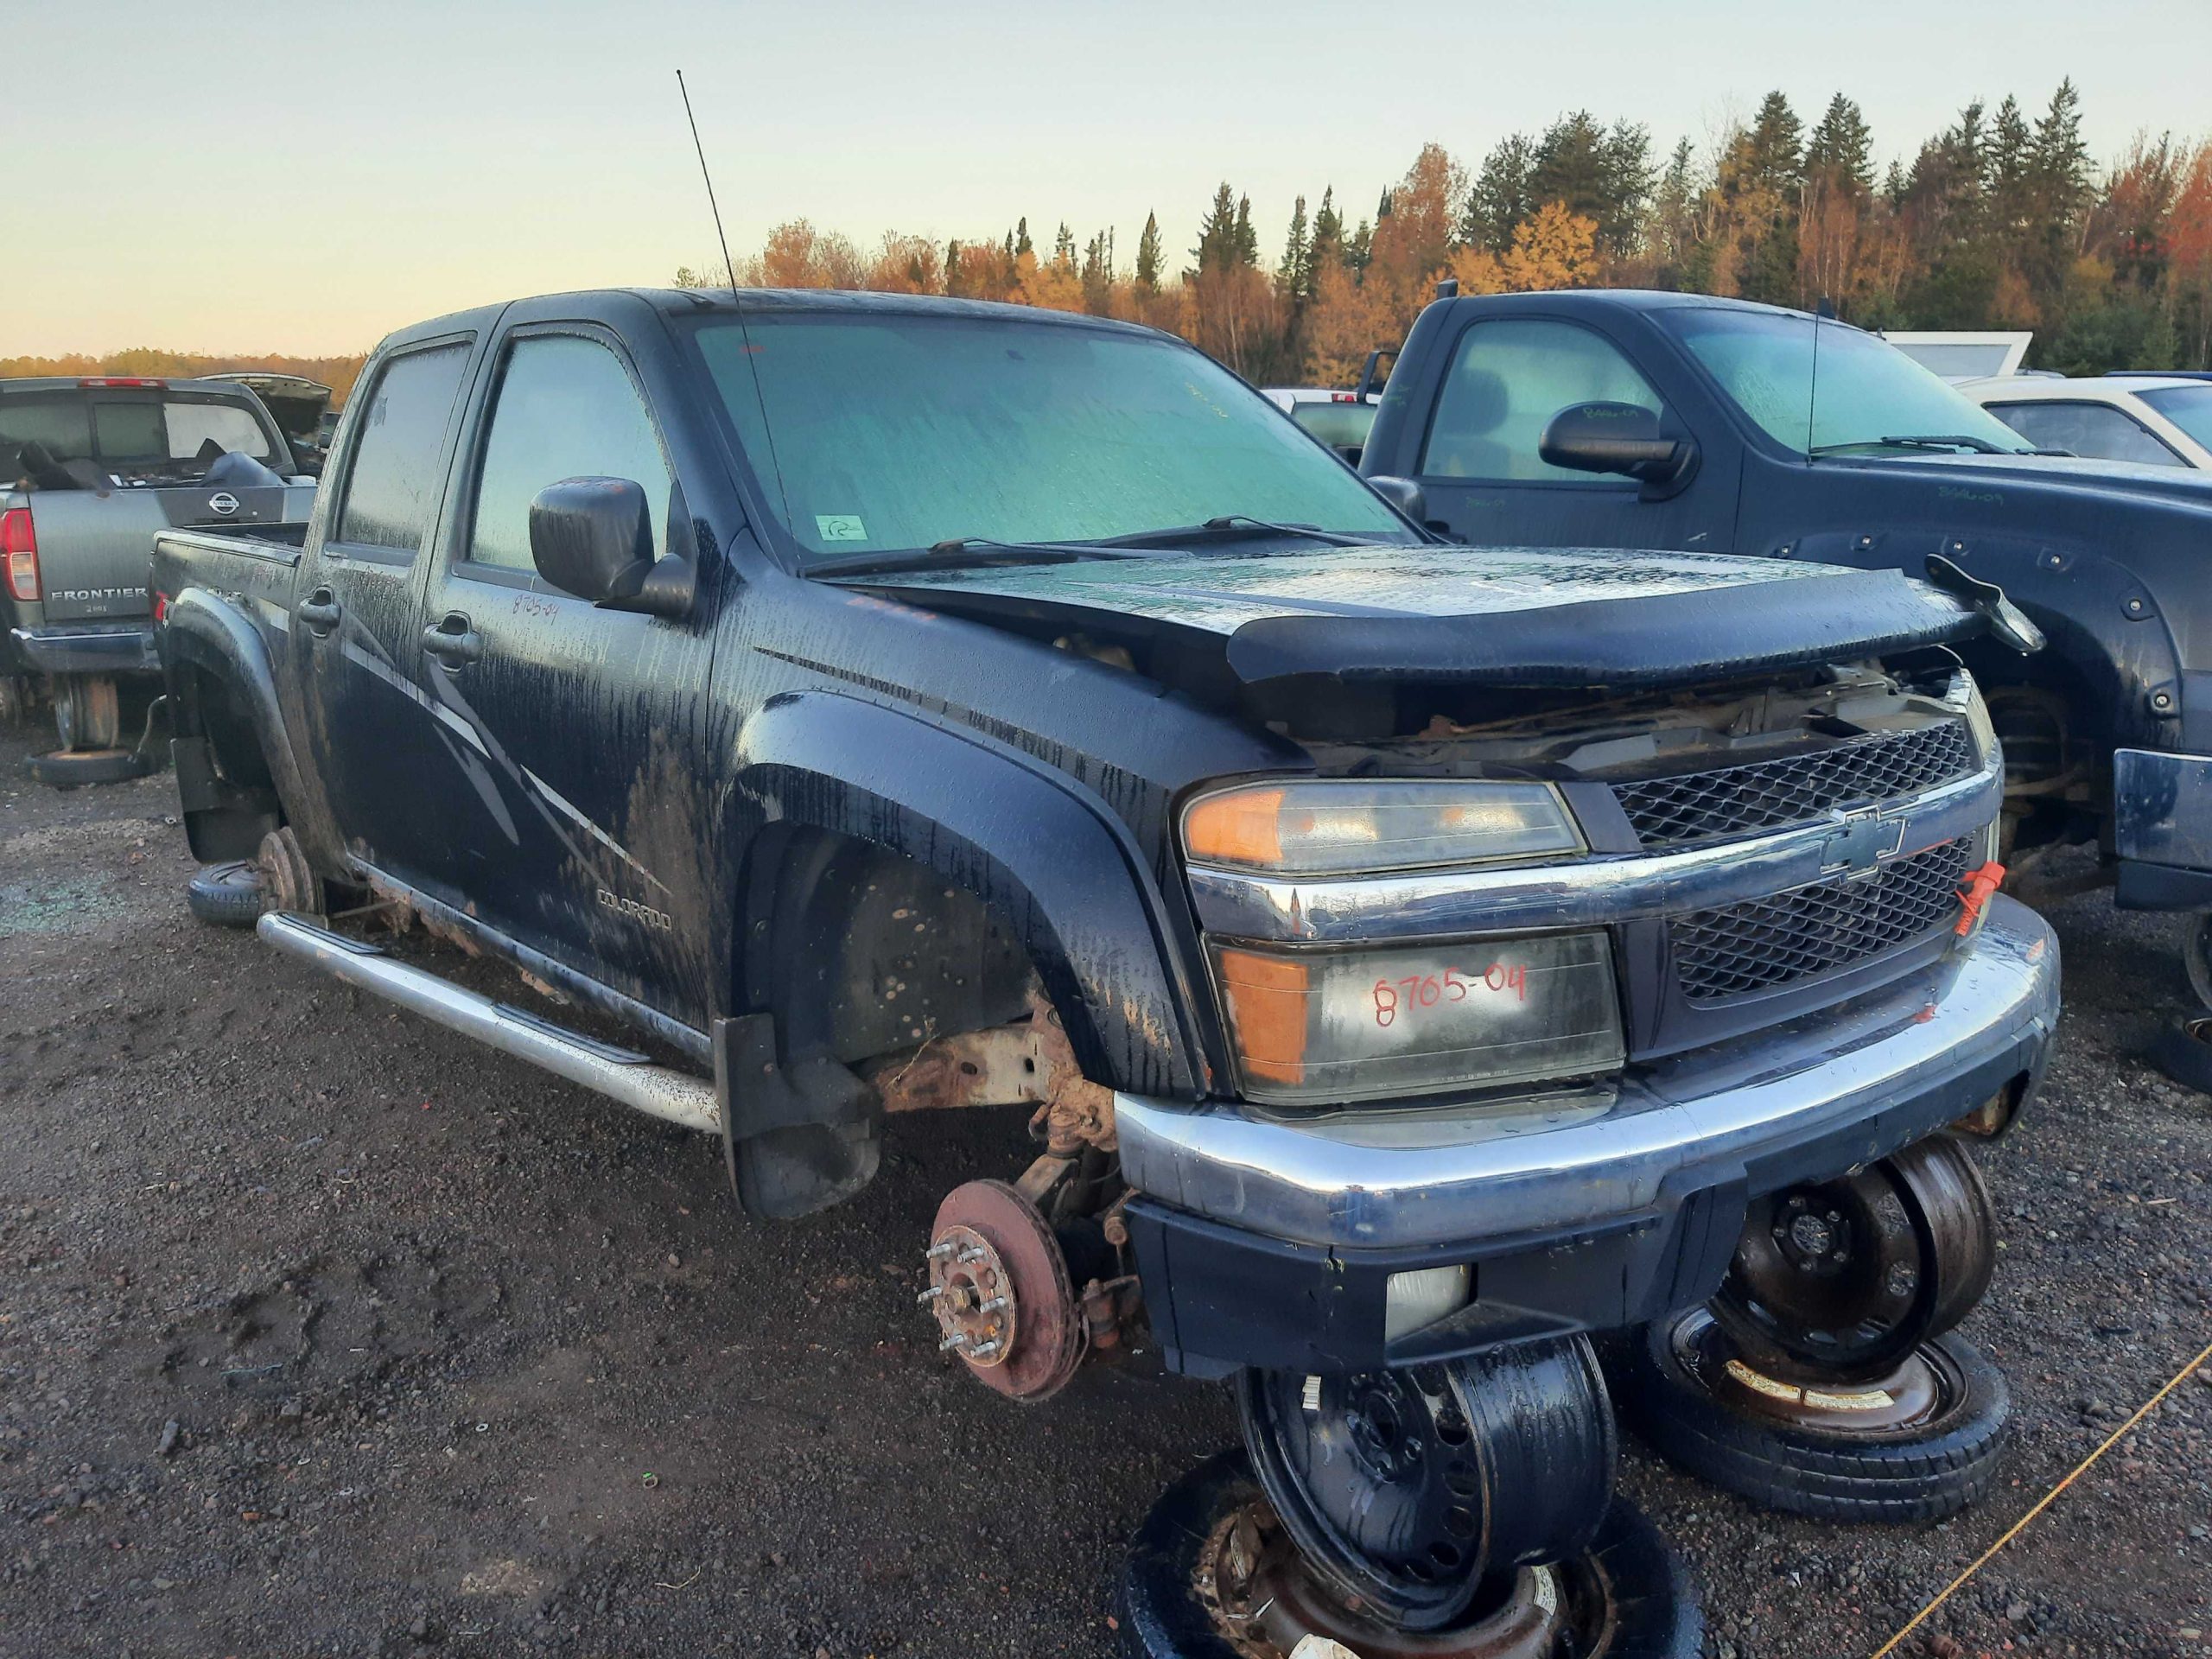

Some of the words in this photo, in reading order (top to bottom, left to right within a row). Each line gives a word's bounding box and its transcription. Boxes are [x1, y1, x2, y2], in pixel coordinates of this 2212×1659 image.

[52, 588, 148, 601] FRONTIER
[597, 888, 671, 933] COLORADO
[1373, 963, 1527, 1027] 8705-04
